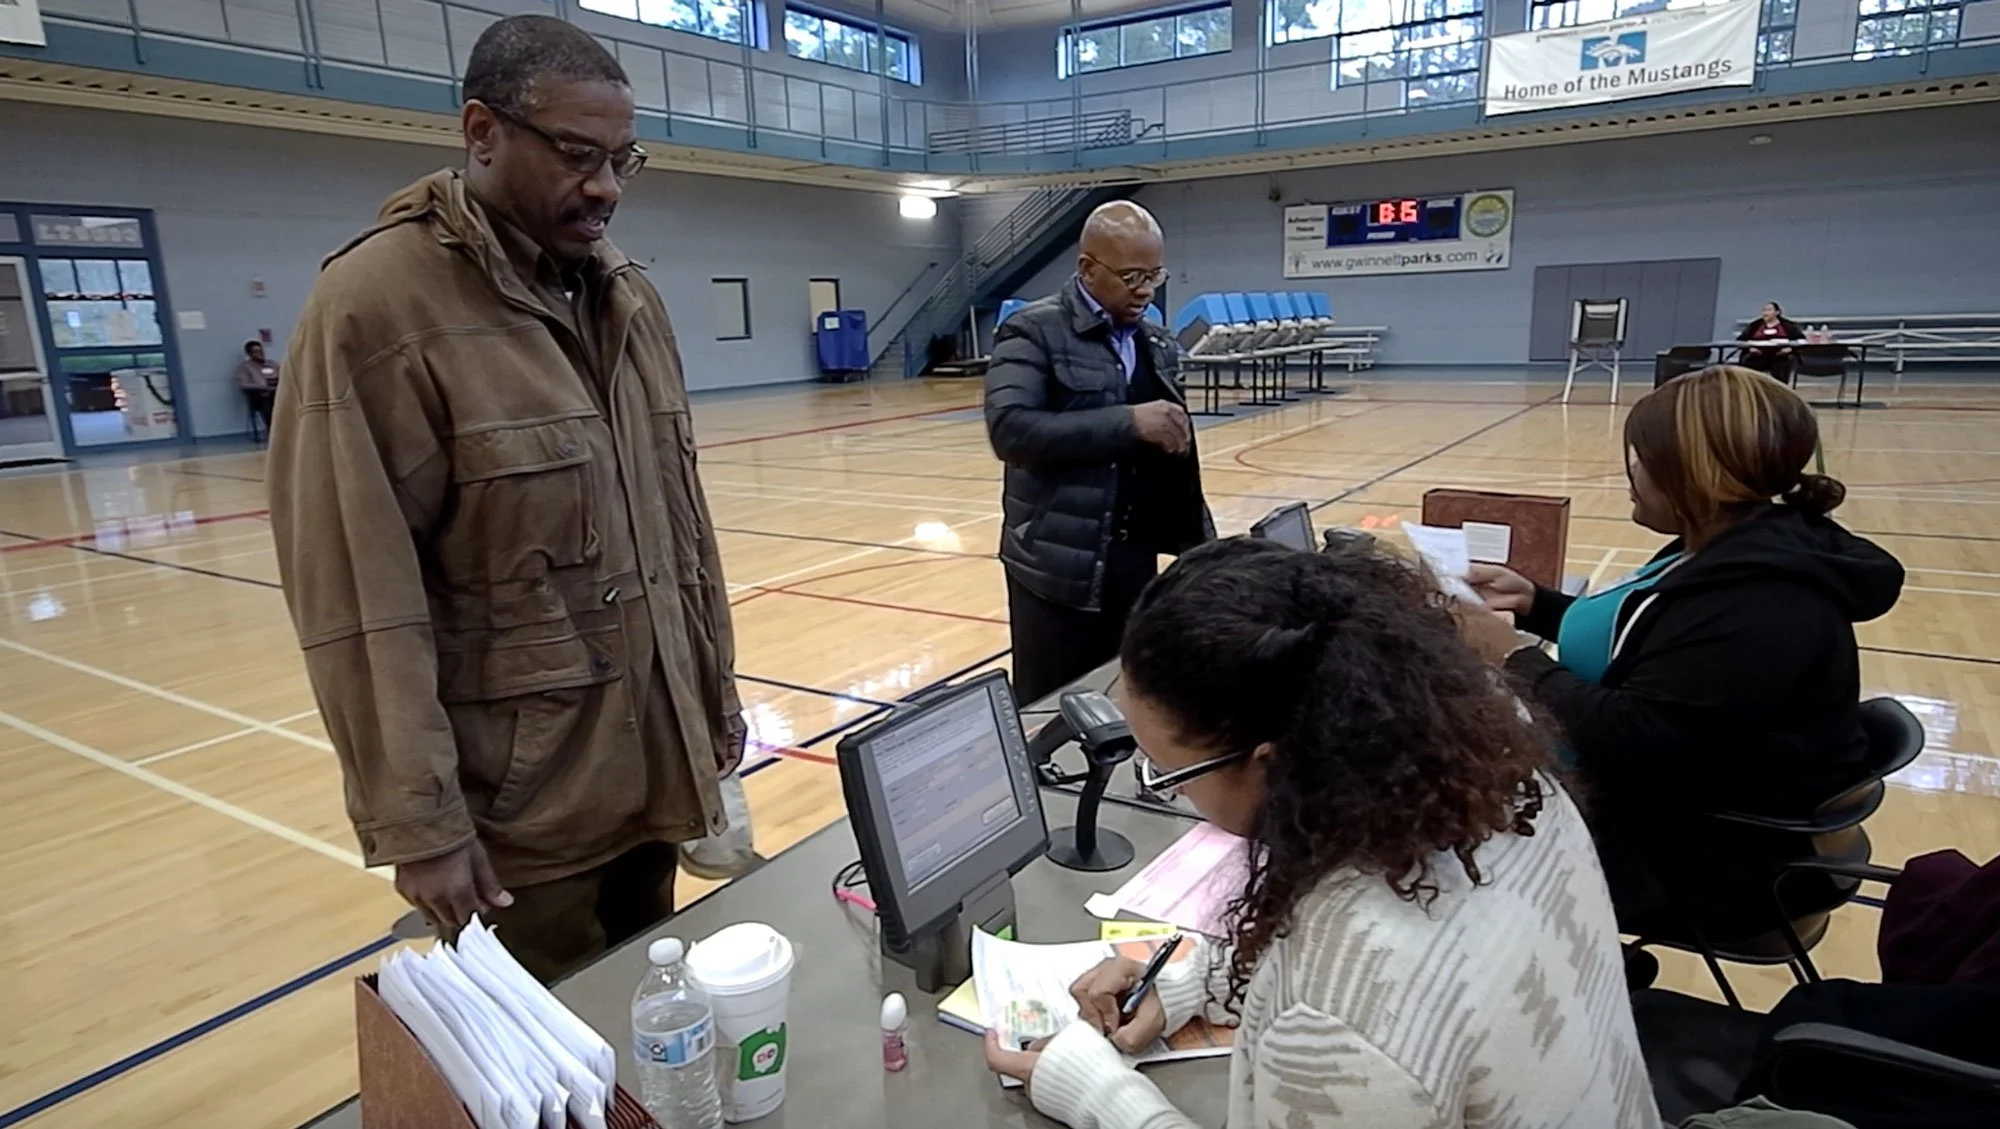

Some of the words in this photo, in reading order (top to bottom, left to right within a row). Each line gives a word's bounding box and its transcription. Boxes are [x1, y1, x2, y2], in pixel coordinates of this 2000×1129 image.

[1504, 82, 1557, 100] Home
[1564, 73, 1584, 94] of
[1590, 69, 1620, 89] the
[1628, 58, 1732, 86] Mustangs
[1312, 251, 1478, 271] www.gwinnettparks.com
